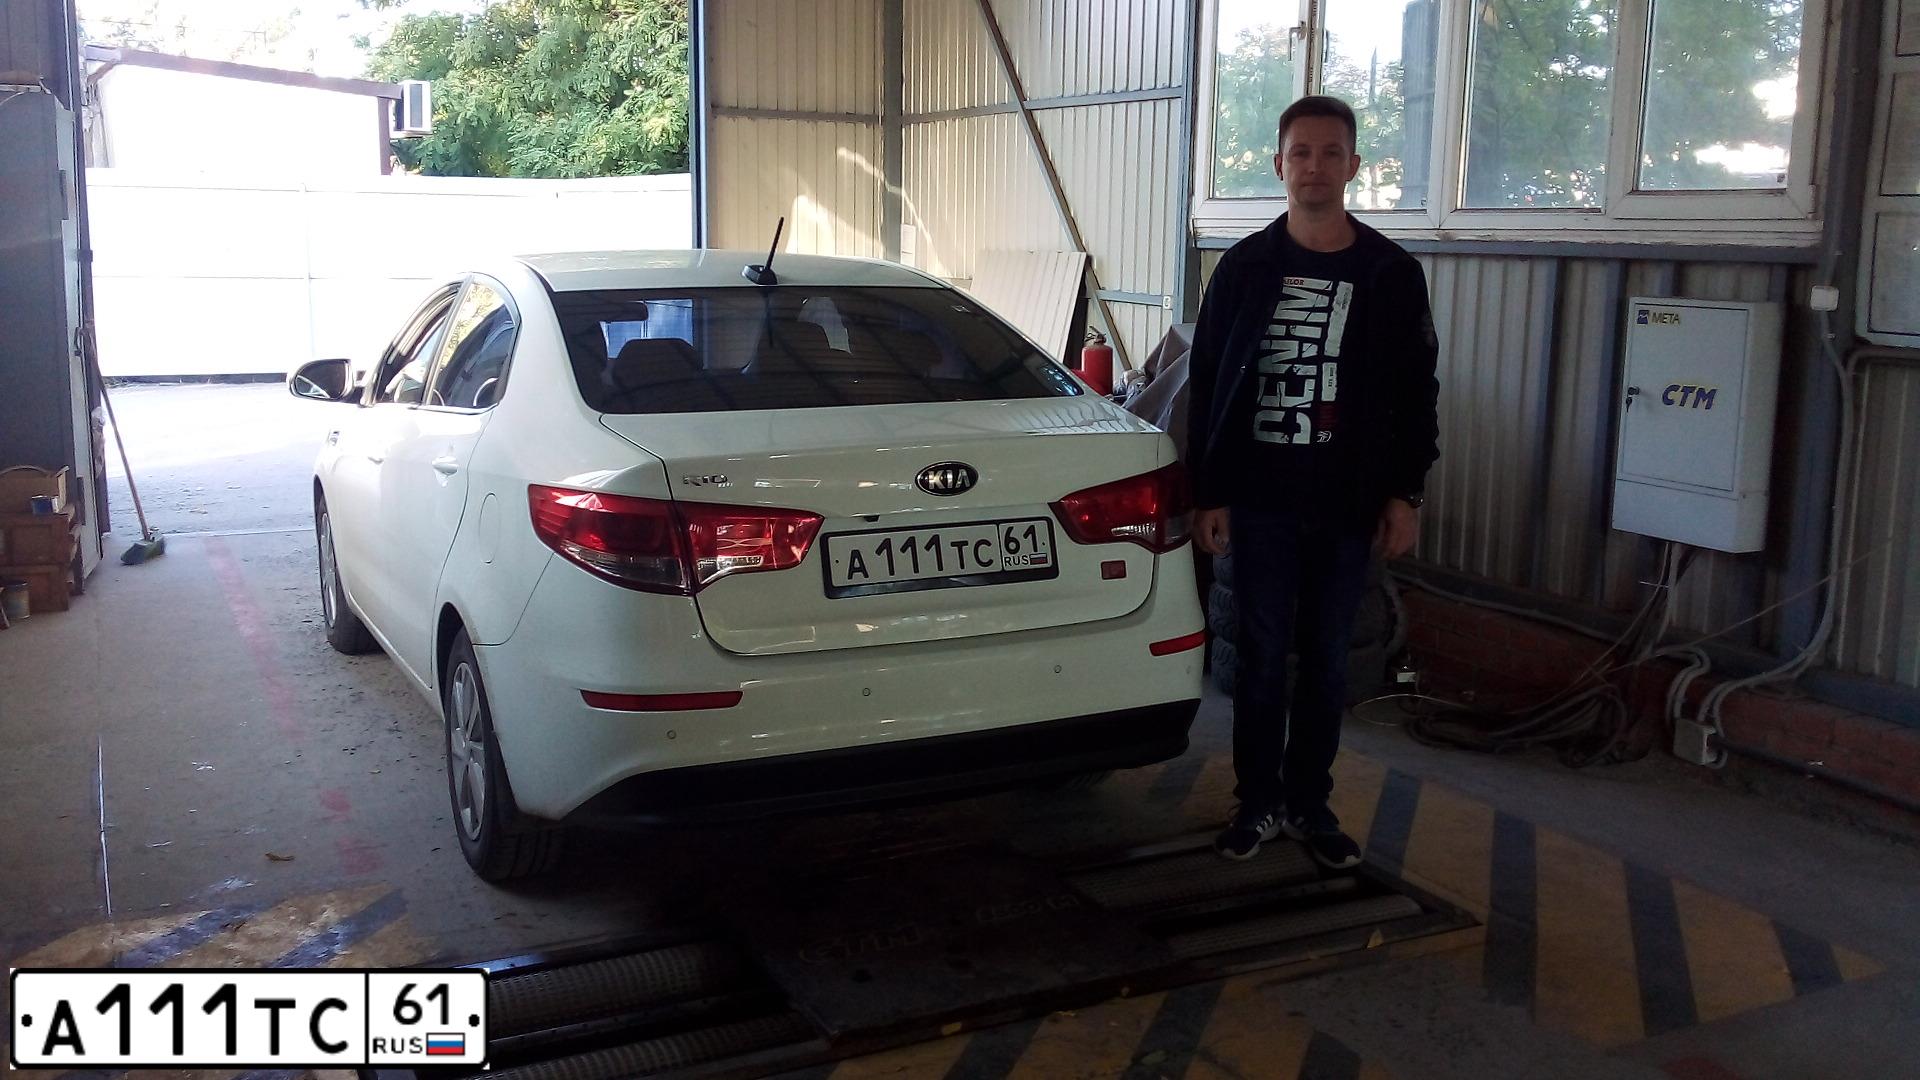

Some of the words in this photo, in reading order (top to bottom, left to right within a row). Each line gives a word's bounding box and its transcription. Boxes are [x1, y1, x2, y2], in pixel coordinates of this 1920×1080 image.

[928, 468, 971, 490] KIA
[1004, 524, 1039, 555] 61
[847, 533, 994, 581] А111ТС
[1003, 554, 1029, 567] RUS
